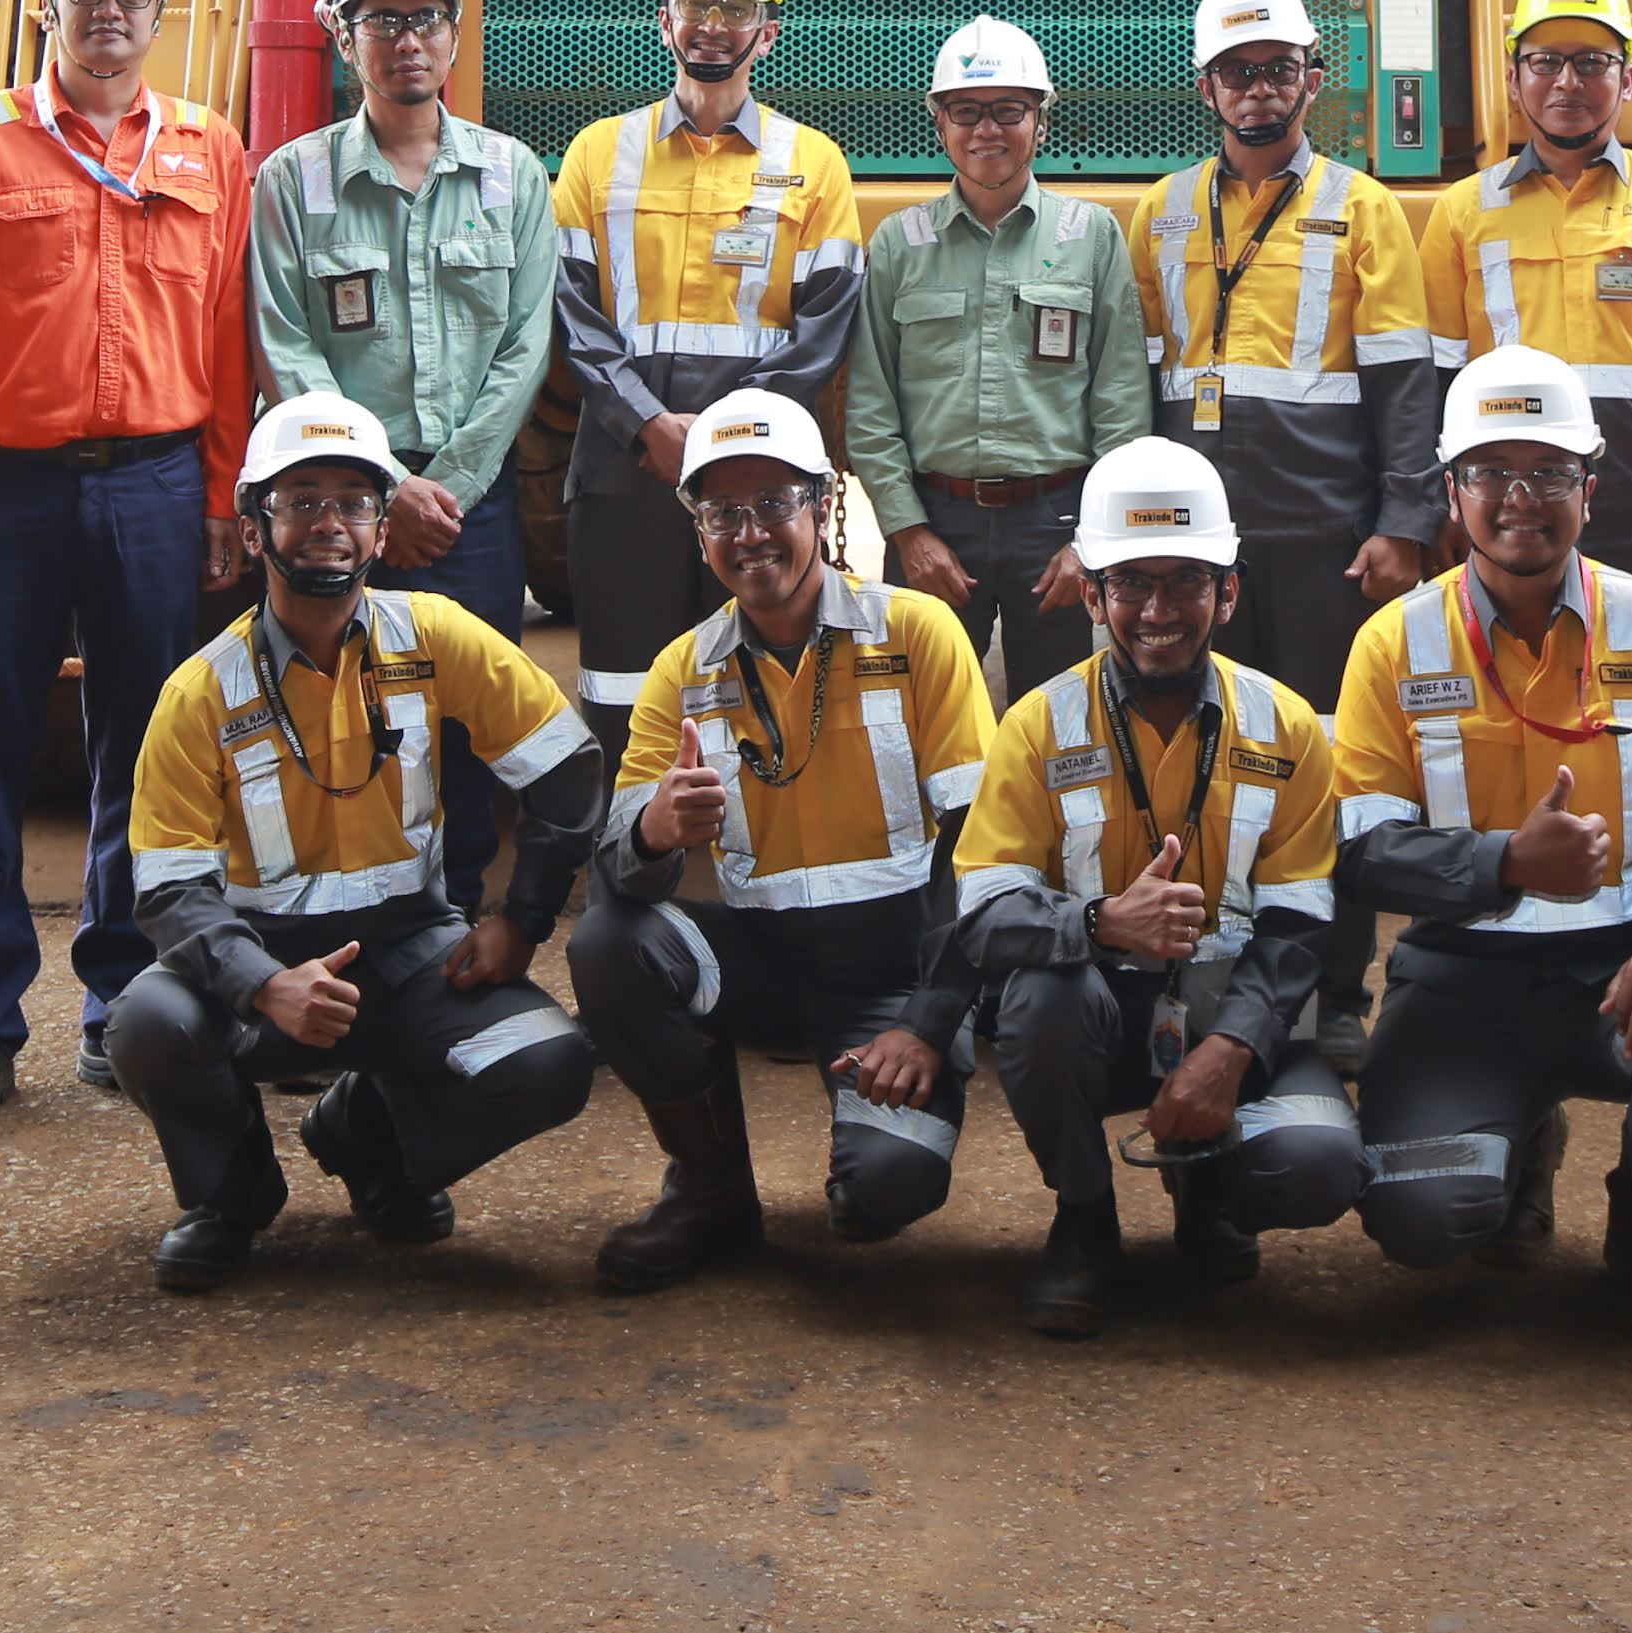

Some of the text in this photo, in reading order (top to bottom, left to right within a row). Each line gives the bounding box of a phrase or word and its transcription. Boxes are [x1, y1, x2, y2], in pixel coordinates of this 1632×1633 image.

[1227, 13, 1255, 25] Trakindo
[978, 58, 1002, 67] VALE
[758, 176, 788, 186] Trakindo
[1302, 221, 1332, 233] Trakindo
[1485, 400, 1522, 412] Trakindo
[310, 426, 346, 436] Trakindo
[717, 426, 751, 439] Trakindo
[1133, 511, 1189, 523] Trakindo CAT
[378, 666, 415, 679] Trakindo
[1409, 681, 1462, 697] ARIEF W Z
[1425, 695, 1457, 705] Executive
[1054, 752, 1102, 774] NATANIEL
[1238, 753, 1276, 773] Trakindo
